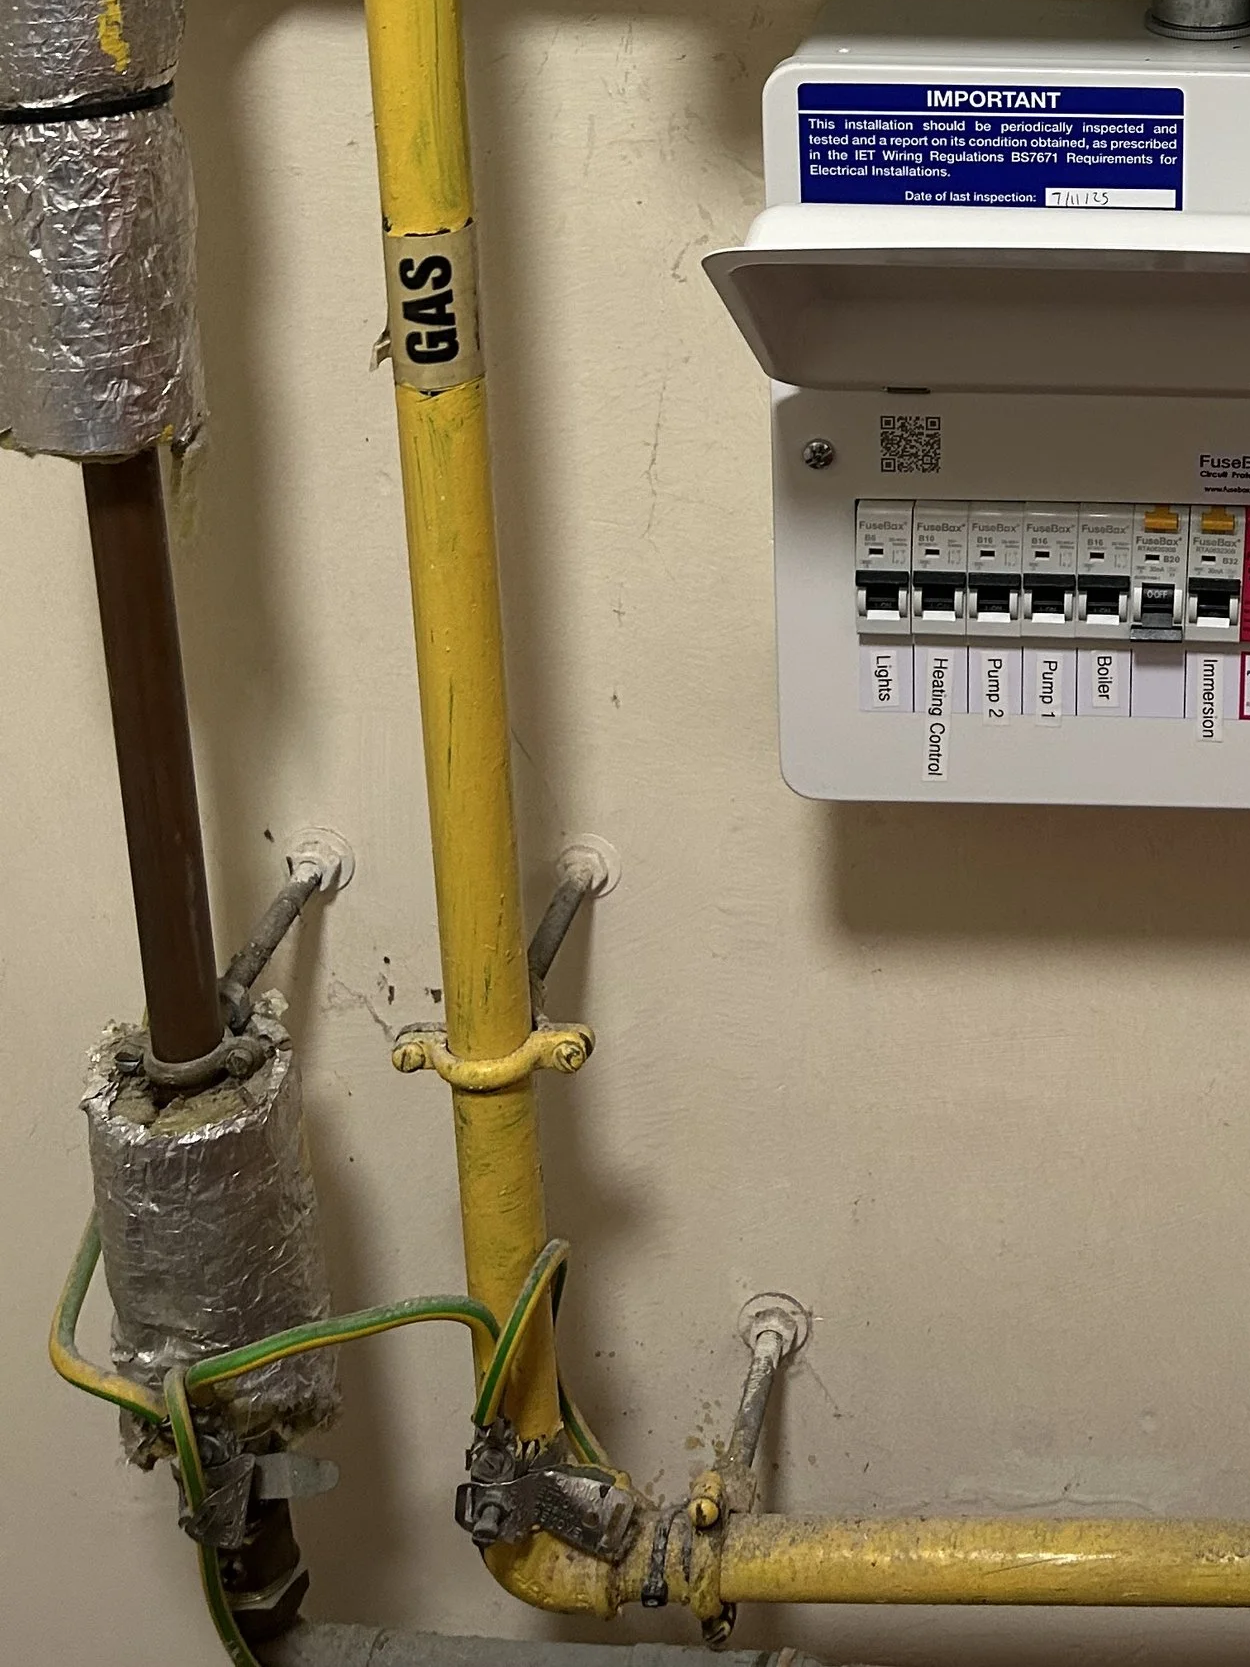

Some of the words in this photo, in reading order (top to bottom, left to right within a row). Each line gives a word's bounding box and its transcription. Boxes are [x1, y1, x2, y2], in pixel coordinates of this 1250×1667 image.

[926, 89, 1062, 110] IMPORTANT
[808, 118, 835, 131] This
[844, 119, 914, 132] installation
[923, 120, 966, 132] should
[975, 120, 991, 132] be
[1000, 120, 1073, 135] periodically
[1082, 122, 1144, 136] inspected
[1153, 122, 1178, 135] and
[808, 133, 849, 147] tested
[851, 134, 876, 147] and
[878, 137, 888, 147] a
[890, 136, 928, 150] report
[931, 138, 948, 148] on
[950, 135, 967, 148] its
[968, 135, 1028, 148] condition
[1030, 136, 1090, 151] obtained,
[1092, 140, 1108, 150] as
[1110, 137, 1177, 152] prescribed
[809, 149, 822, 161] in
[827, 149, 848, 161] the
[855, 149, 875, 161] IET
[882, 150, 923, 165] Wiring
[929, 151, 1005, 166] Regulations
[1011, 151, 1059, 163] BS7671
[1066, 152, 1154, 168] Requirements
[1159, 153, 1178, 165] for
[809, 164, 869, 177] Electrical
[871, 165, 951, 178] Installations.
[905, 190, 929, 202] Date
[931, 190, 946, 203] of
[948, 191, 970, 203] last
[973, 191, 1037, 206] inspection:
[398, 255, 460, 365] GAS
[1200, 470, 1229, 478] Circuit
[859, 521, 904, 530] FuseBox
[916, 522, 962, 532] FuseBox
[971, 522, 1017, 533] FuseBox
[1026, 523, 1071, 533] FuseBox
[1081, 524, 1126, 534] FuseBox
[1136, 536, 1179, 546] FuseBox
[1193, 537, 1237, 547] FuseBox
[1163, 555, 1180, 563] B20
[1222, 557, 1238, 565] B32
[875, 654, 892, 702] Lights
[986, 658, 1003, 704] Pump
[1039, 659, 1058, 705] Pump
[1096, 655, 1112, 700] Boiler
[927, 657, 949, 717] Heating
[1199, 659, 1218, 739] Immersion
[988, 708, 1004, 718] 2
[927, 722, 946, 776] Control
